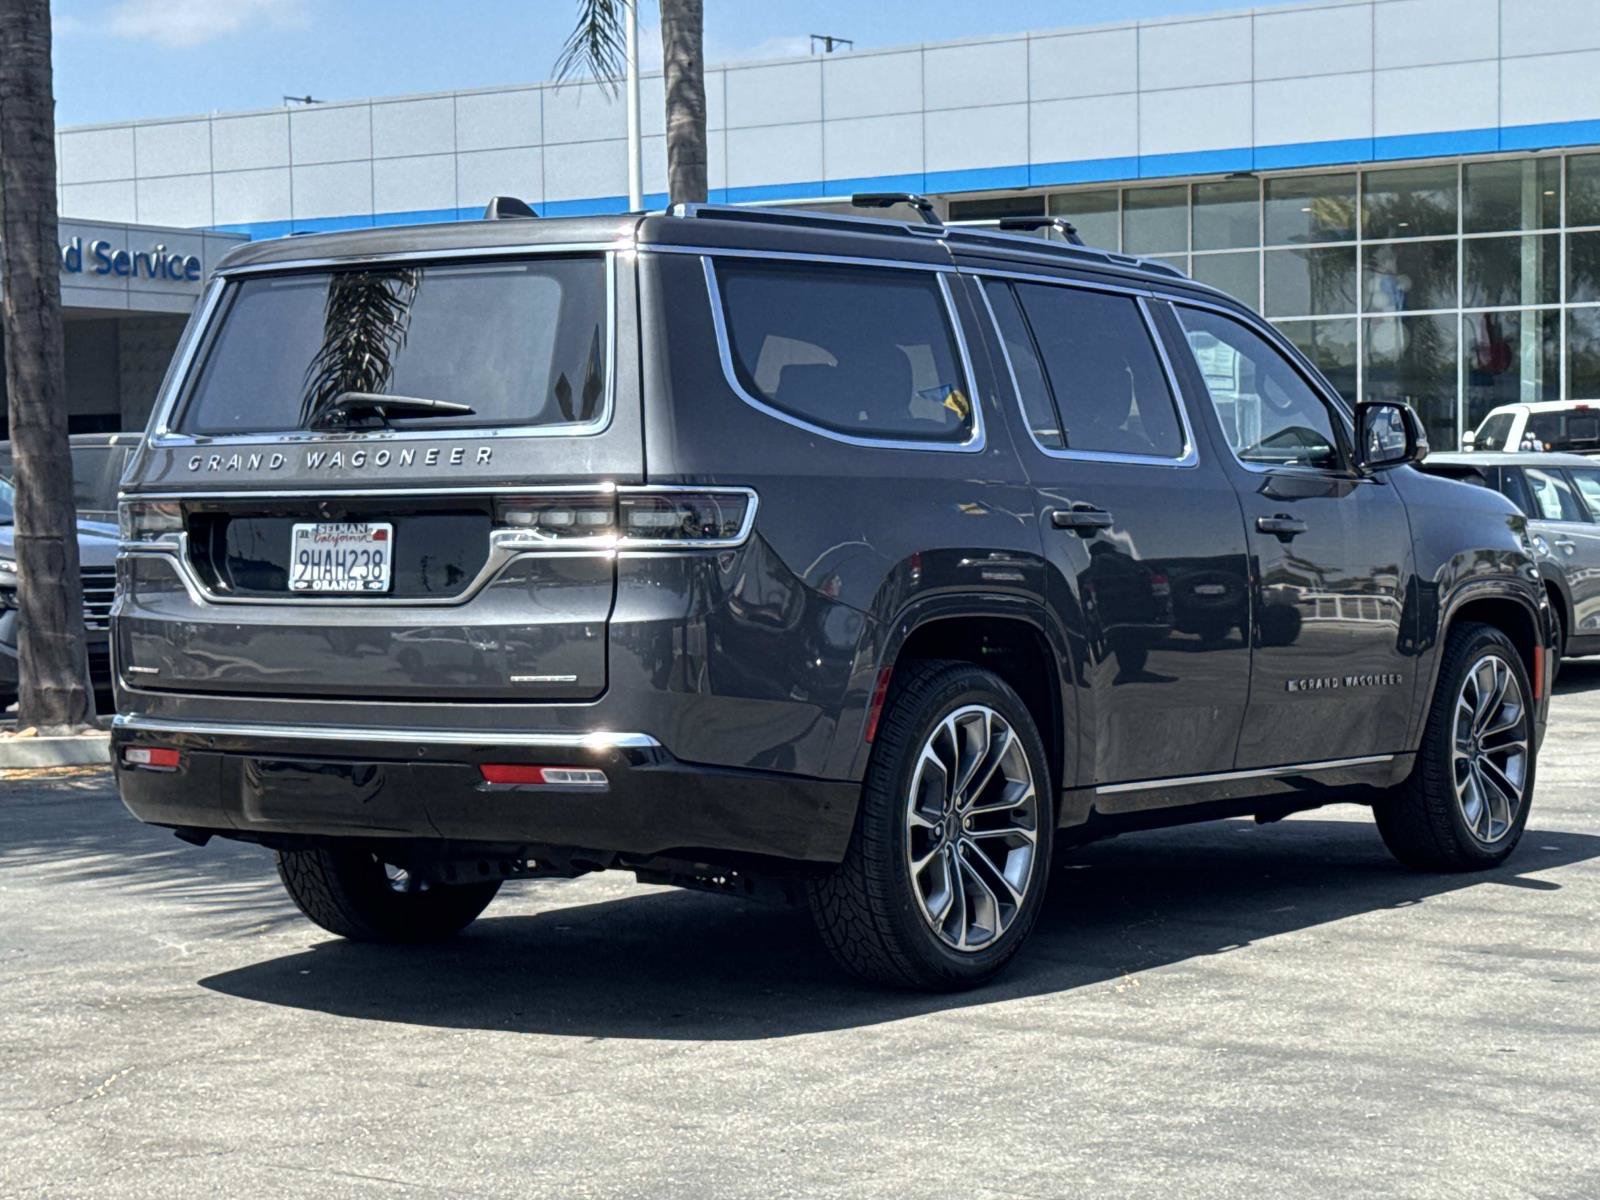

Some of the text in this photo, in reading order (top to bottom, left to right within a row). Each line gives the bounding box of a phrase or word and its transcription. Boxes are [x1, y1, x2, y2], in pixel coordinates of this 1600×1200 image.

[90, 240, 201, 282] Service
[188, 446, 494, 471] GRAND WAGONEER
[317, 523, 367, 533] SELMAN
[299, 549, 383, 580] 9HAH238
[312, 580, 365, 590] ORANGE
[1300, 674, 1403, 690] GRAND WAGONEER
